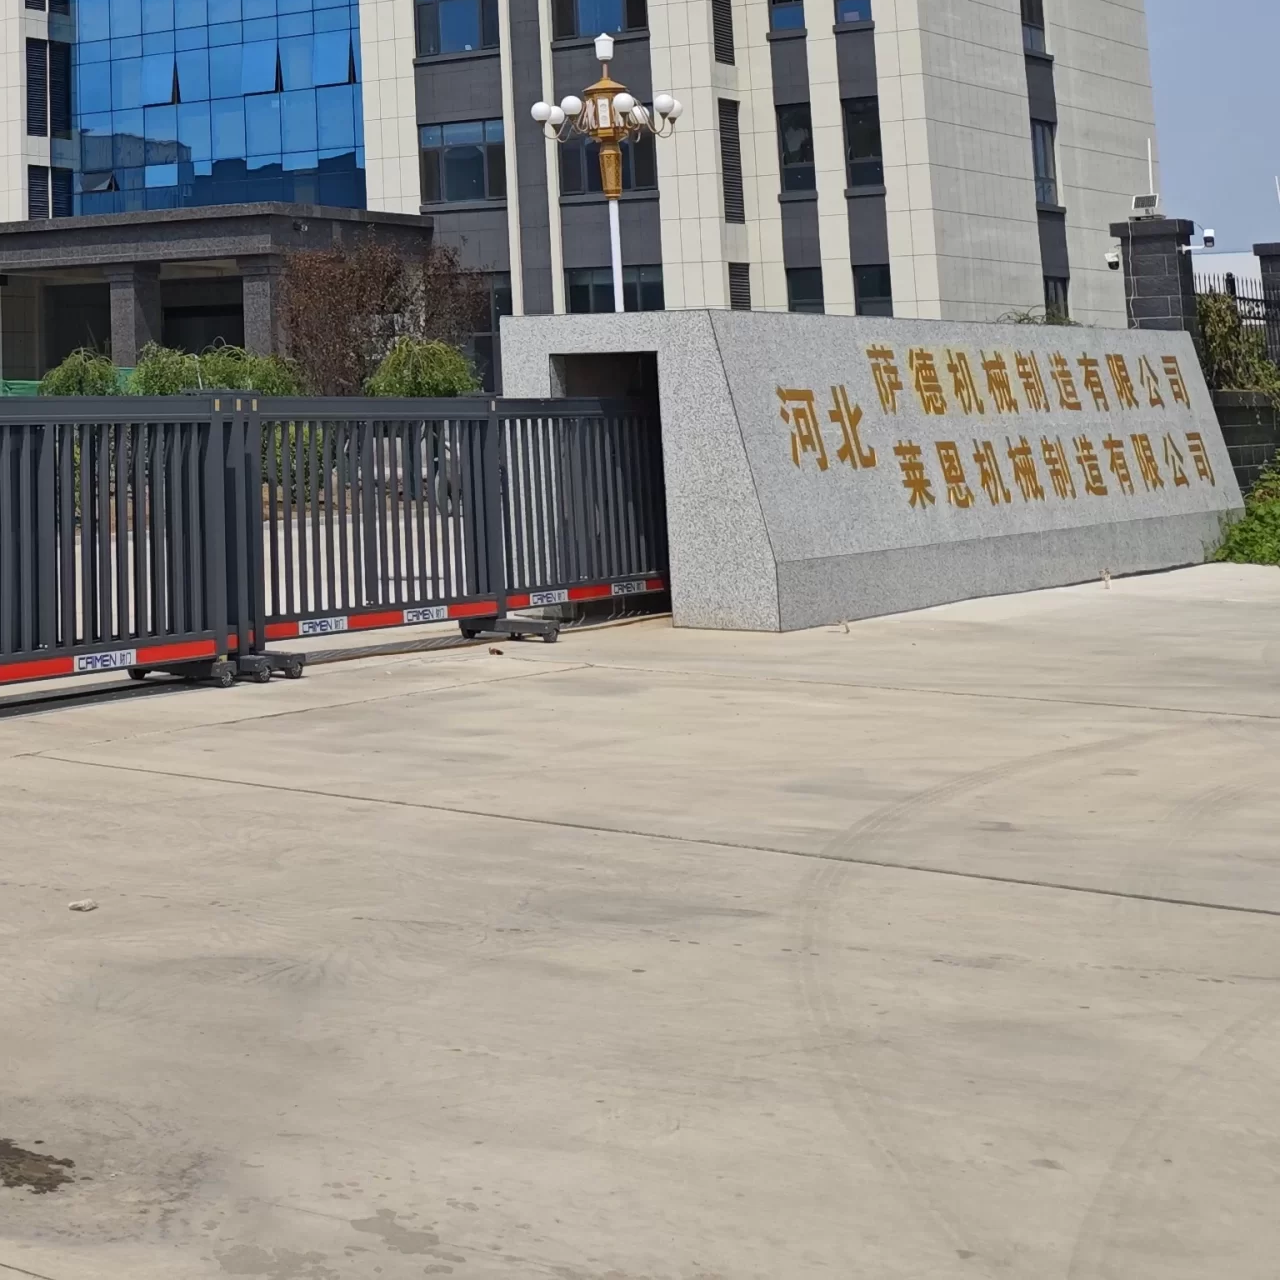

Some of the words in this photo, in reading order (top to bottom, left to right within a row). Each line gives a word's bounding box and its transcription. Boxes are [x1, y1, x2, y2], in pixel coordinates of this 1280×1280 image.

[866, 344, 1191, 415] 萨德机械制造有限公司
[776, 384, 877, 472] 河北
[893, 432, 1215, 509] 莱恩机械制造有限公司
[78, 653, 117, 670] CAIMEN
